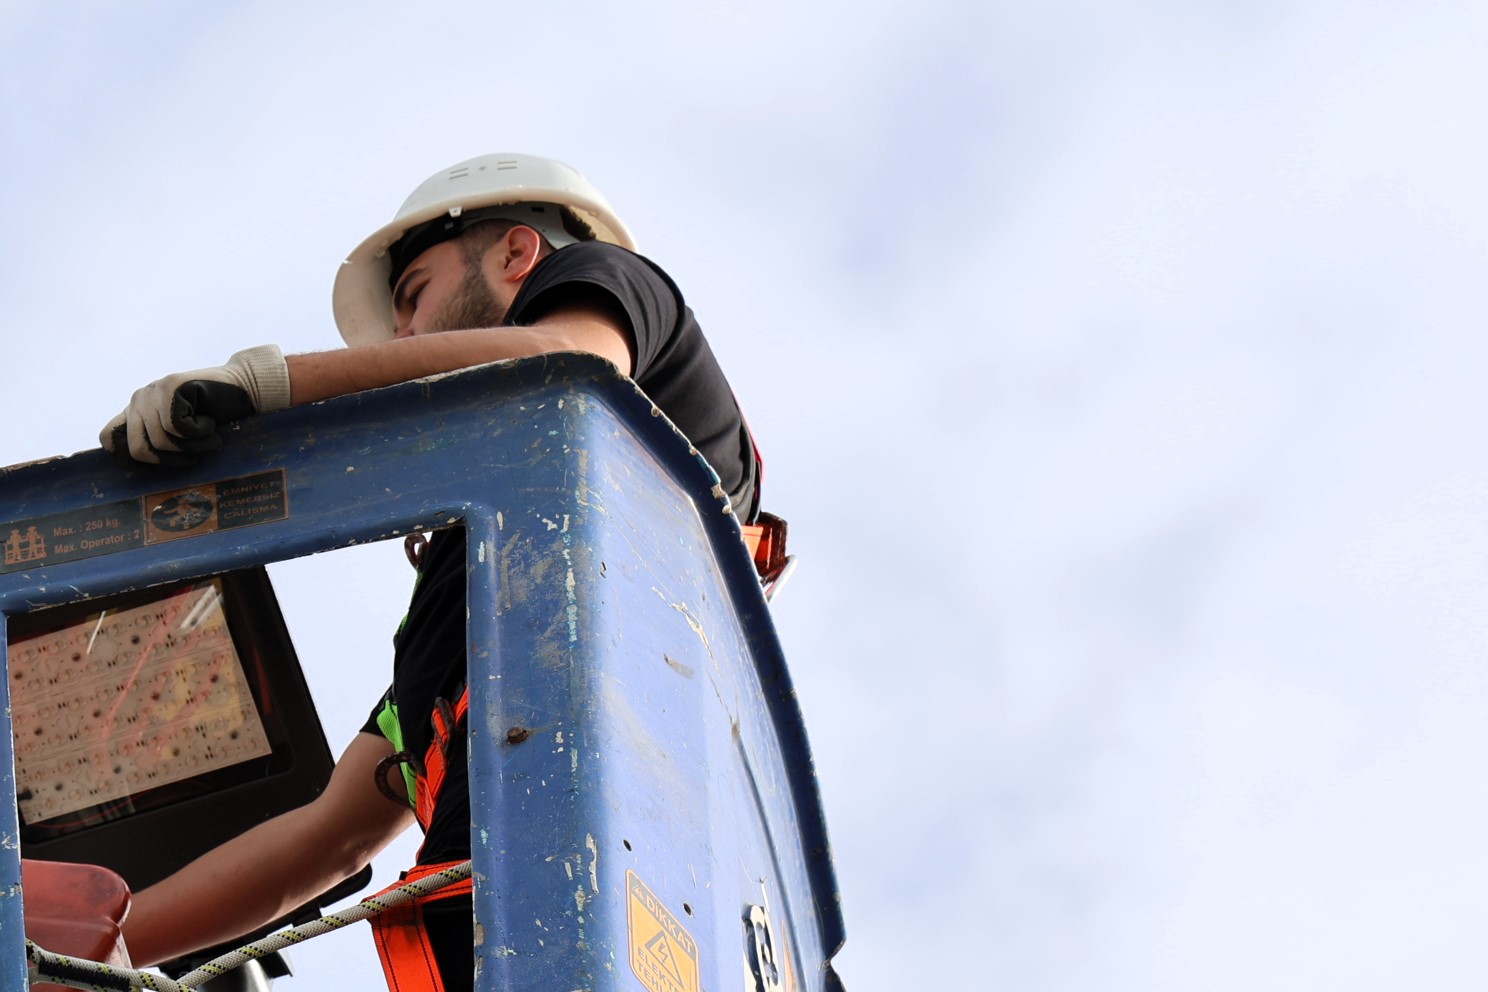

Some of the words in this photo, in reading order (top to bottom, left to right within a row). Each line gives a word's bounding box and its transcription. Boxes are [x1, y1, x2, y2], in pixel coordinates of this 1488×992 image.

[53, 526, 77, 537] Max.
[85, 519, 103, 531] 250
[106, 517, 121, 528] kg.
[54, 544, 78, 554] Max.
[80, 534, 125, 550] Operator
[645, 895, 693, 955] DİKKAT
